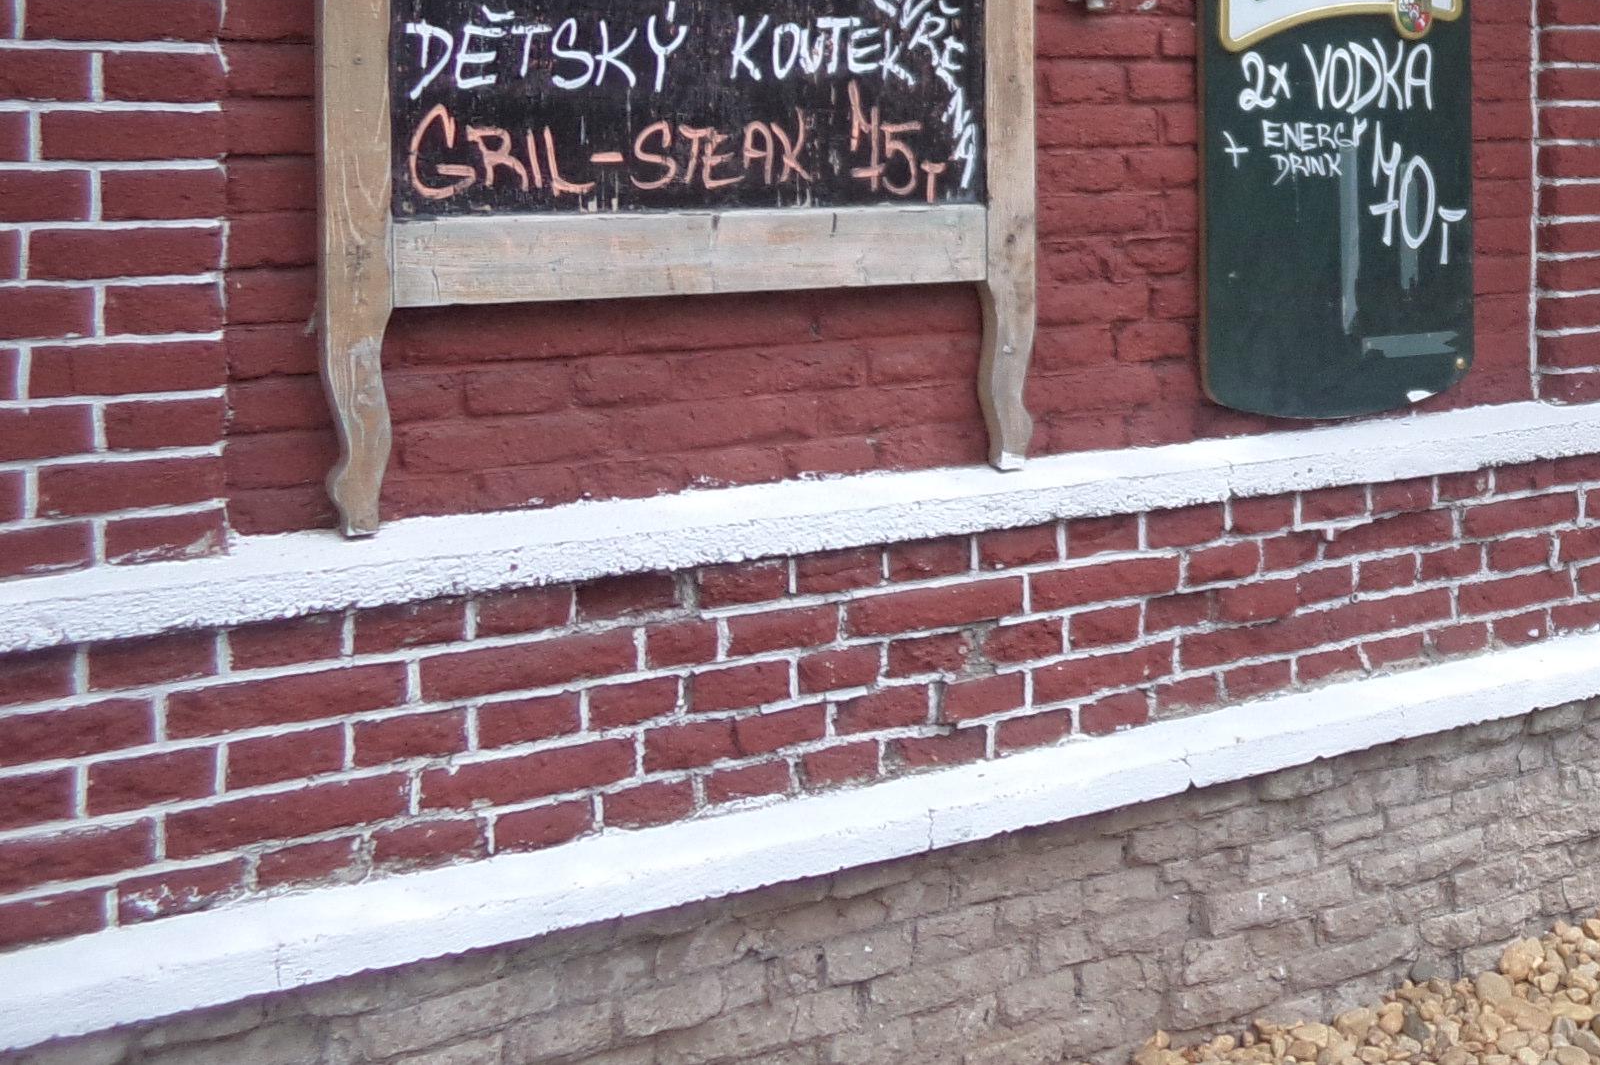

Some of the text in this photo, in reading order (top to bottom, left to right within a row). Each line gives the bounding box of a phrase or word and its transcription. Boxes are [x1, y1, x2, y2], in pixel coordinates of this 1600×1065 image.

[406, 0, 915, 100] DĚTSKÝ KOUTEK
[1302, 37, 1433, 114] VODKA
[1261, 116, 1369, 152] ENERGY
[1269, 152, 1343, 186] DRINK
